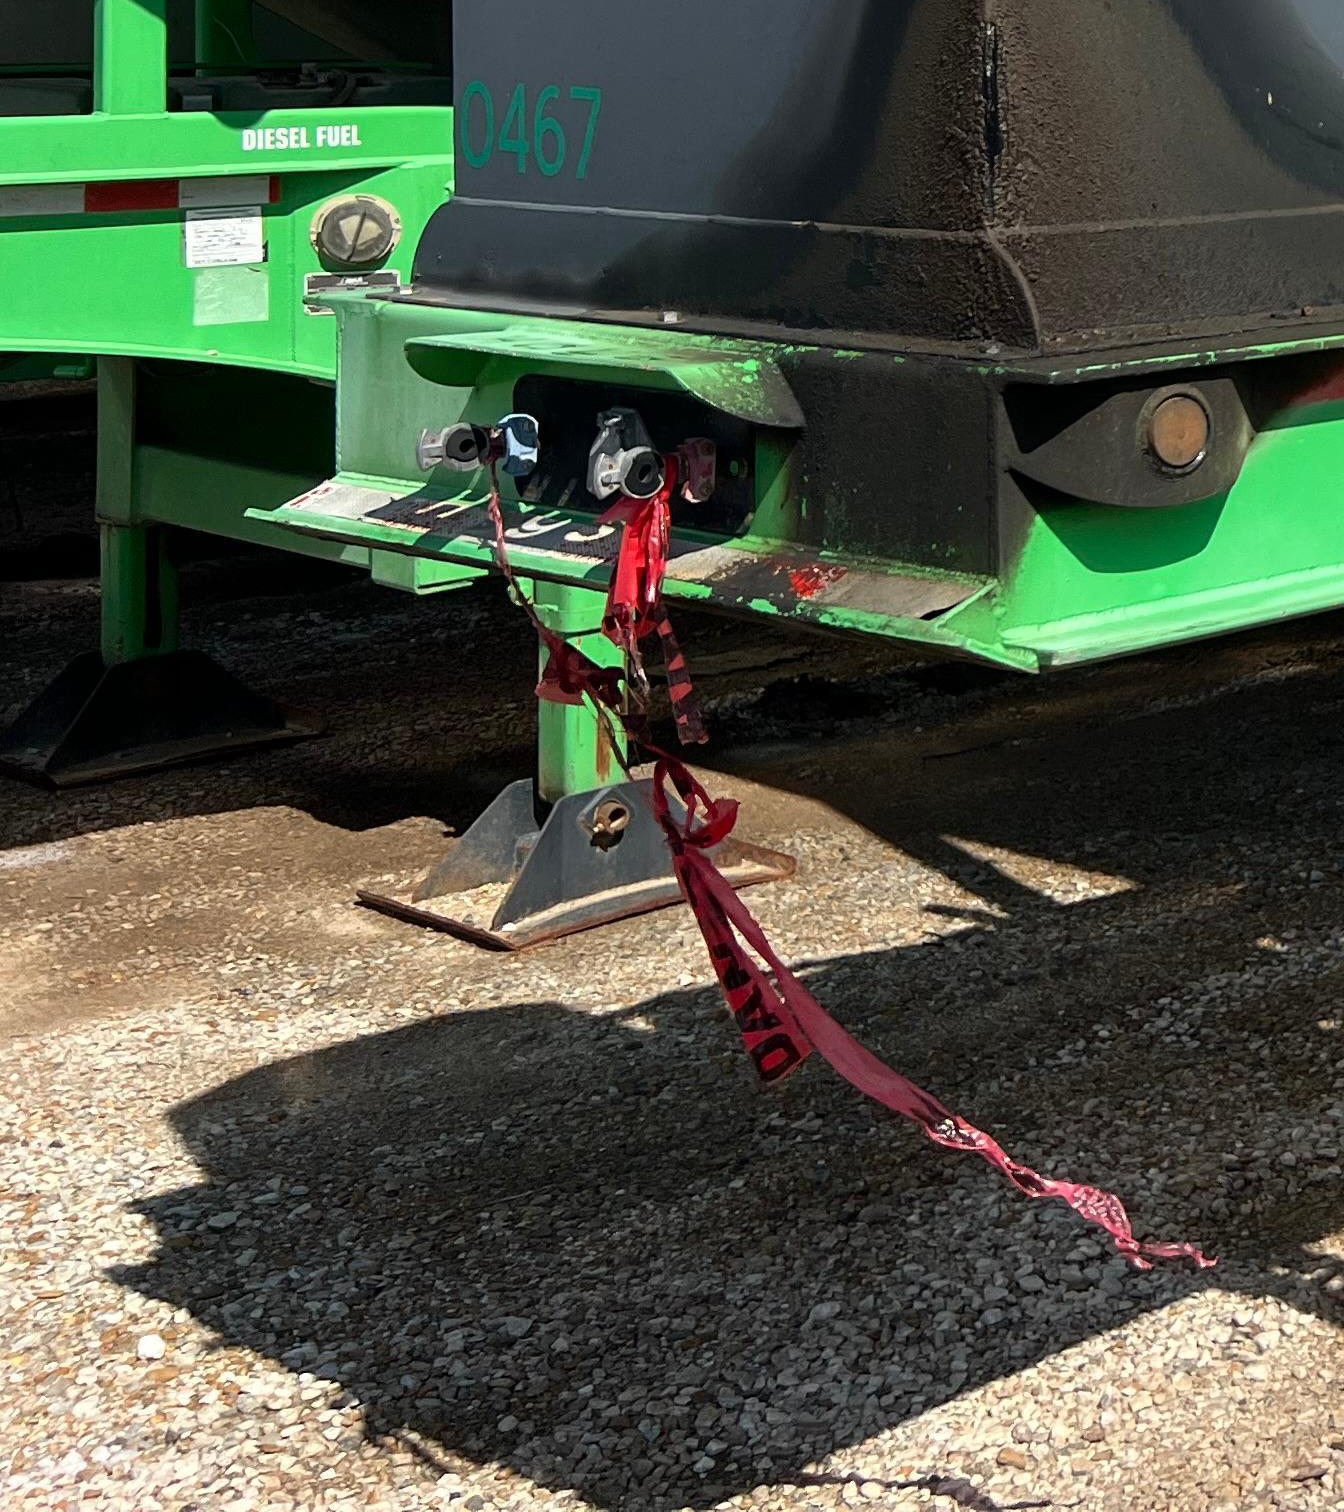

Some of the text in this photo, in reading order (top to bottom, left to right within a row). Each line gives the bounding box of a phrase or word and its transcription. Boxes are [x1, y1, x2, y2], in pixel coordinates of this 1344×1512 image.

[242, 124, 362, 151] DIESEL FUEL
[461, 80, 602, 180] 0467
